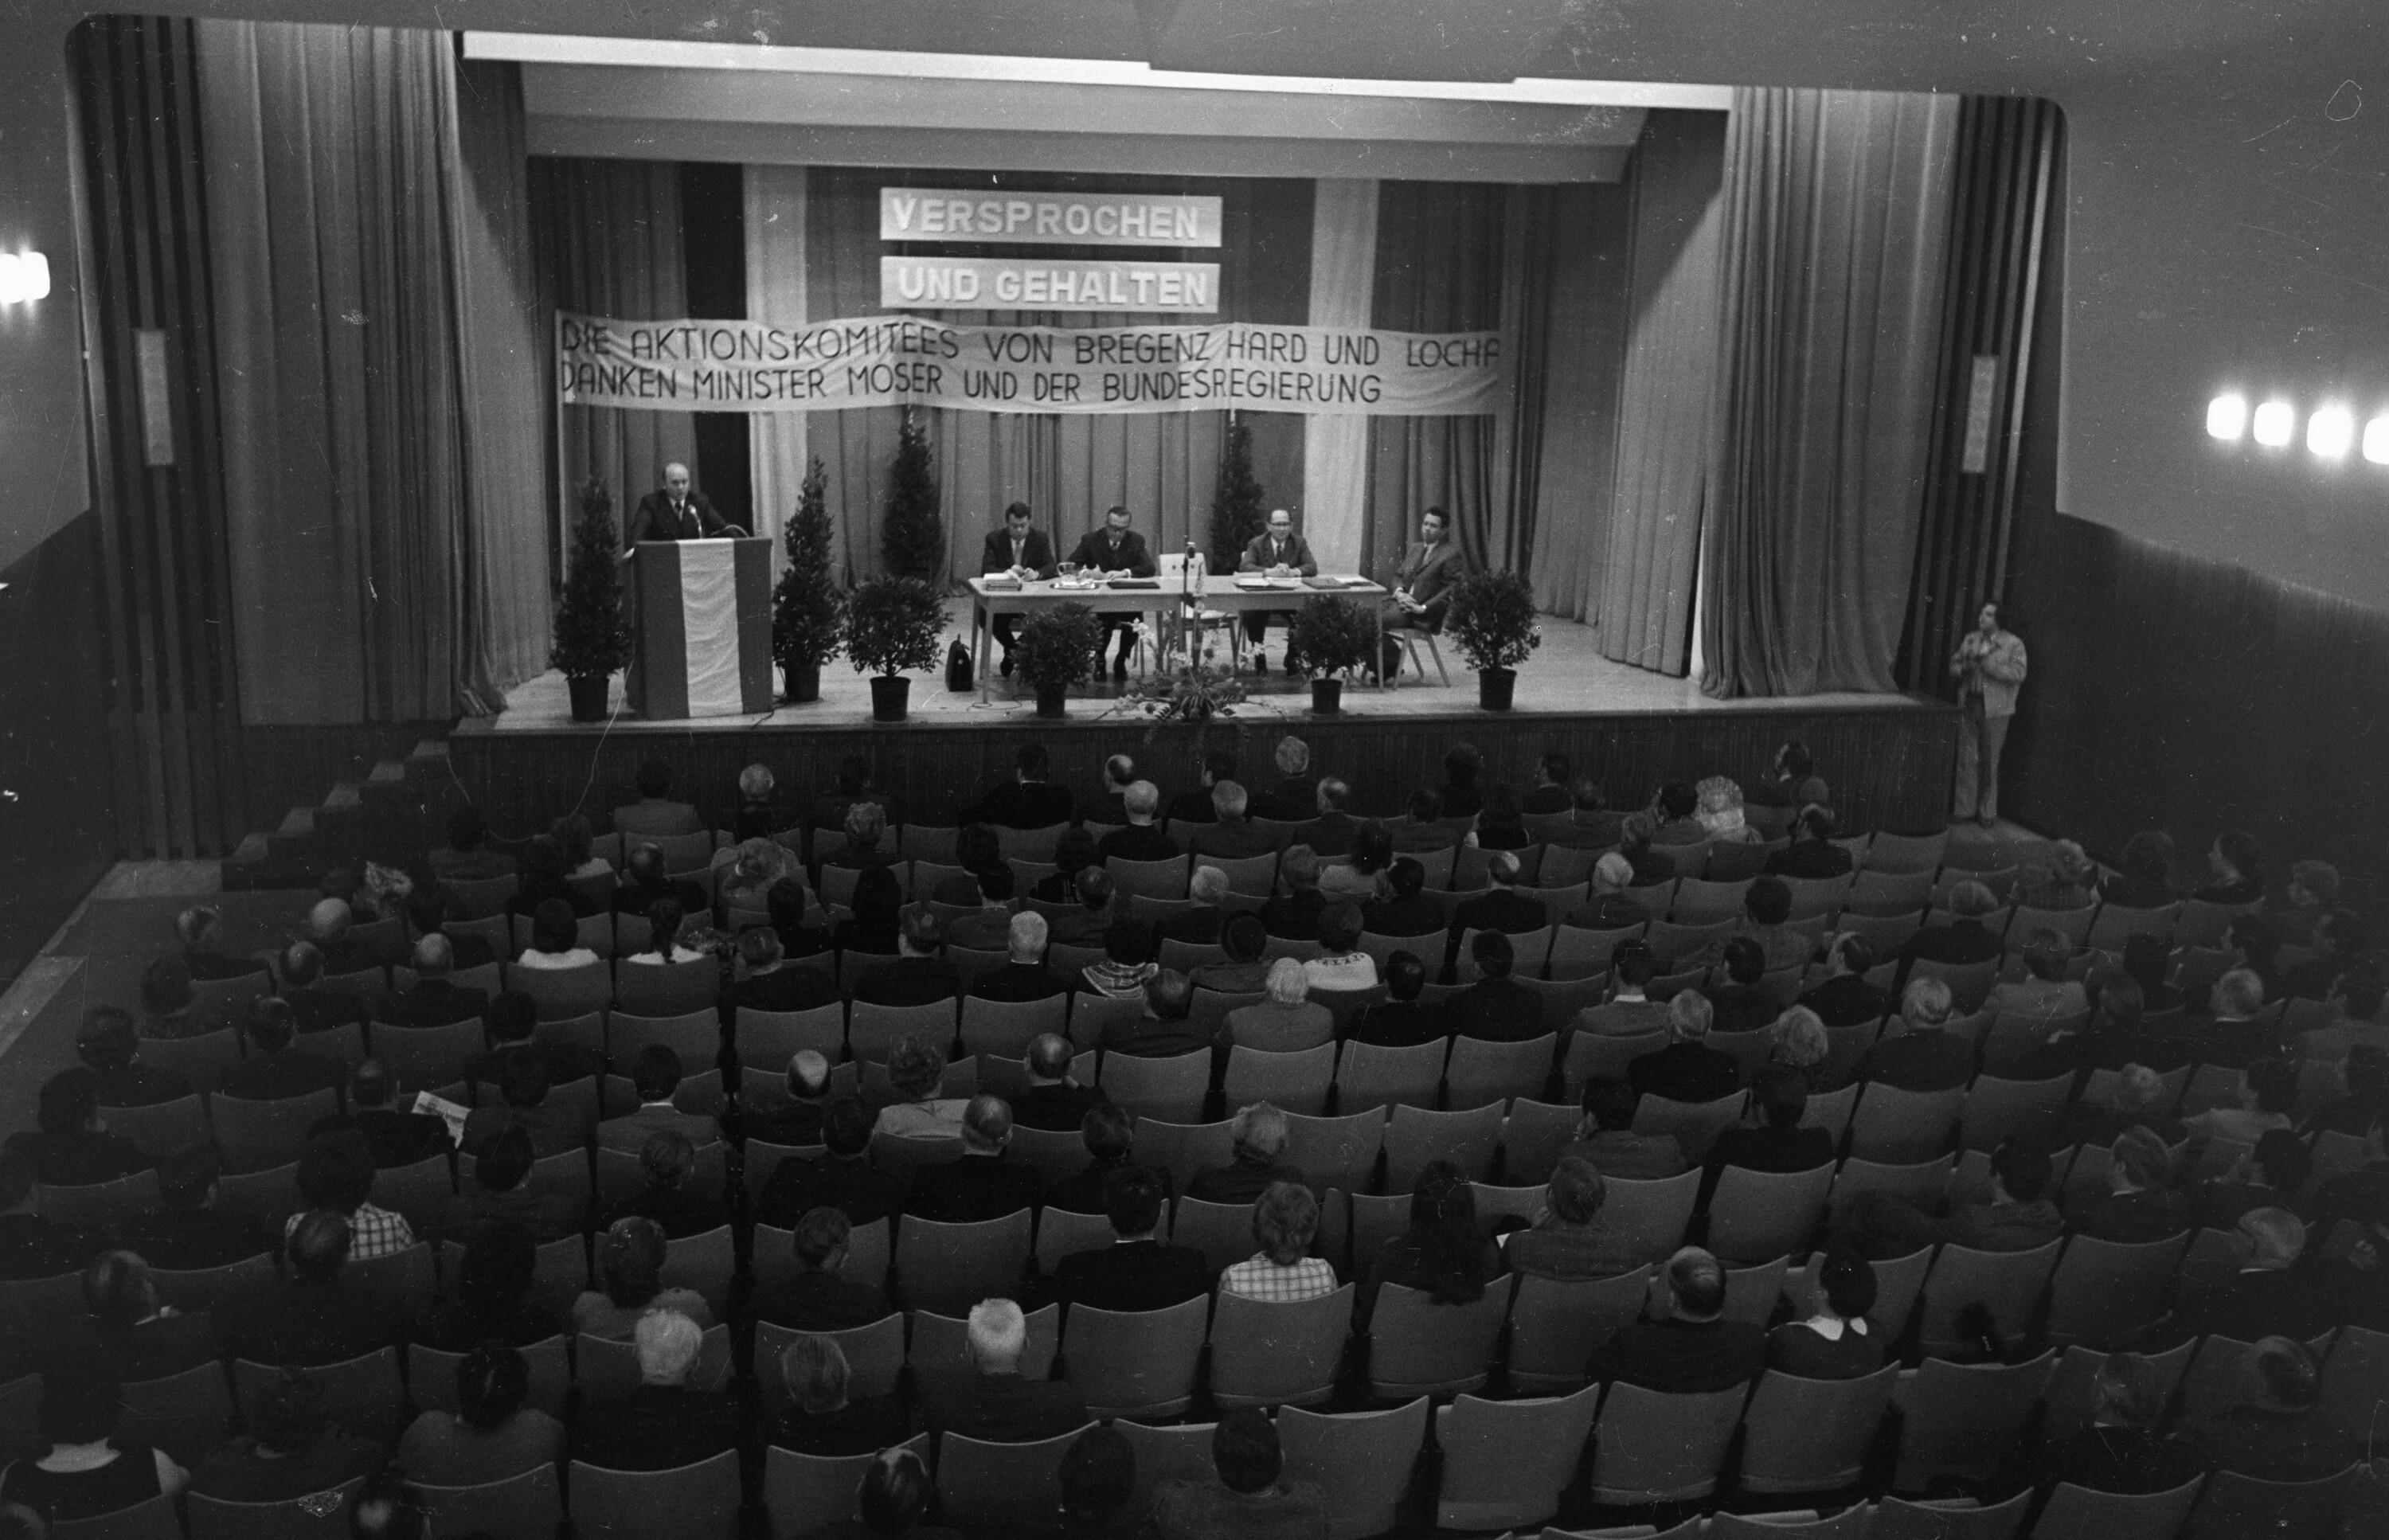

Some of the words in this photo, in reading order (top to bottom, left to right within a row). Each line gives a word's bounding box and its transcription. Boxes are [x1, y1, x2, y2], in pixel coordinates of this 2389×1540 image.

[892, 196, 1198, 238] VERSPROCHEN
[898, 266, 980, 301] UND
[995, 270, 1207, 306] GEHALTEN
[561, 319, 611, 355] DIE
[631, 322, 960, 361] AKTIONSKOMITEES
[983, 332, 1053, 364] VON
[1075, 331, 1211, 365] BREGENZ
[1227, 330, 1307, 363] HARD
[1324, 335, 1381, 365] UND
[561, 361, 678, 398] DANKEN
[693, 368, 827, 400] MINISTER
[847, 363, 943, 395] MOSER
[963, 369, 1017, 400] UND
[1034, 373, 1081, 402] DER
[1102, 367, 1382, 403] BUNDESREGIERUNG
